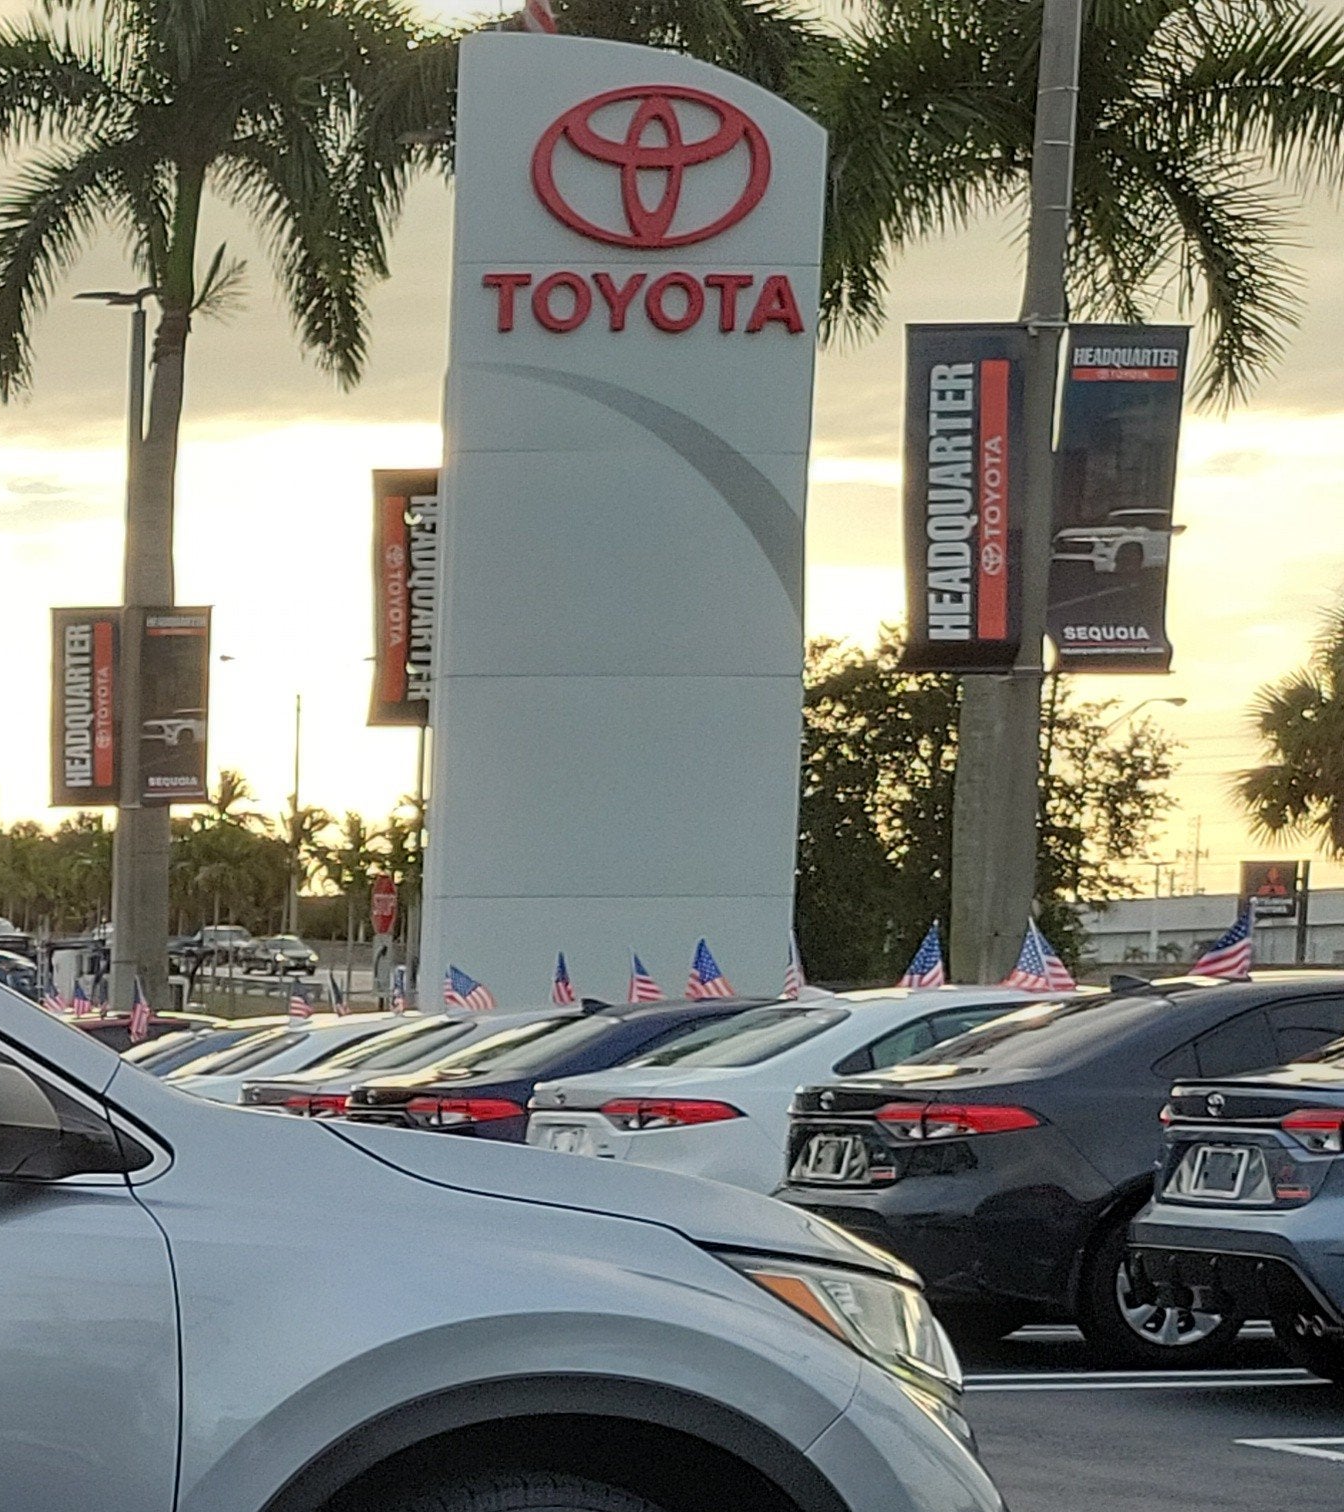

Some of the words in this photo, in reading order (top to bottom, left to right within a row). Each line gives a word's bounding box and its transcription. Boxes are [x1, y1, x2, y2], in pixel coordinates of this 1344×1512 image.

[482, 271, 805, 333] TOYOTA
[1073, 347, 1179, 369] HEADQUARTER
[927, 361, 978, 641] HEADQUARTER
[984, 434, 1002, 540] TOYOTA
[386, 569, 407, 649] TOYOTA
[1062, 624, 1150, 641] SEQUOIA
[64, 623, 95, 788] HEADQUARTER
[96, 666, 111, 730] TOYOTA
[147, 775, 199, 788] SEQUOIA
